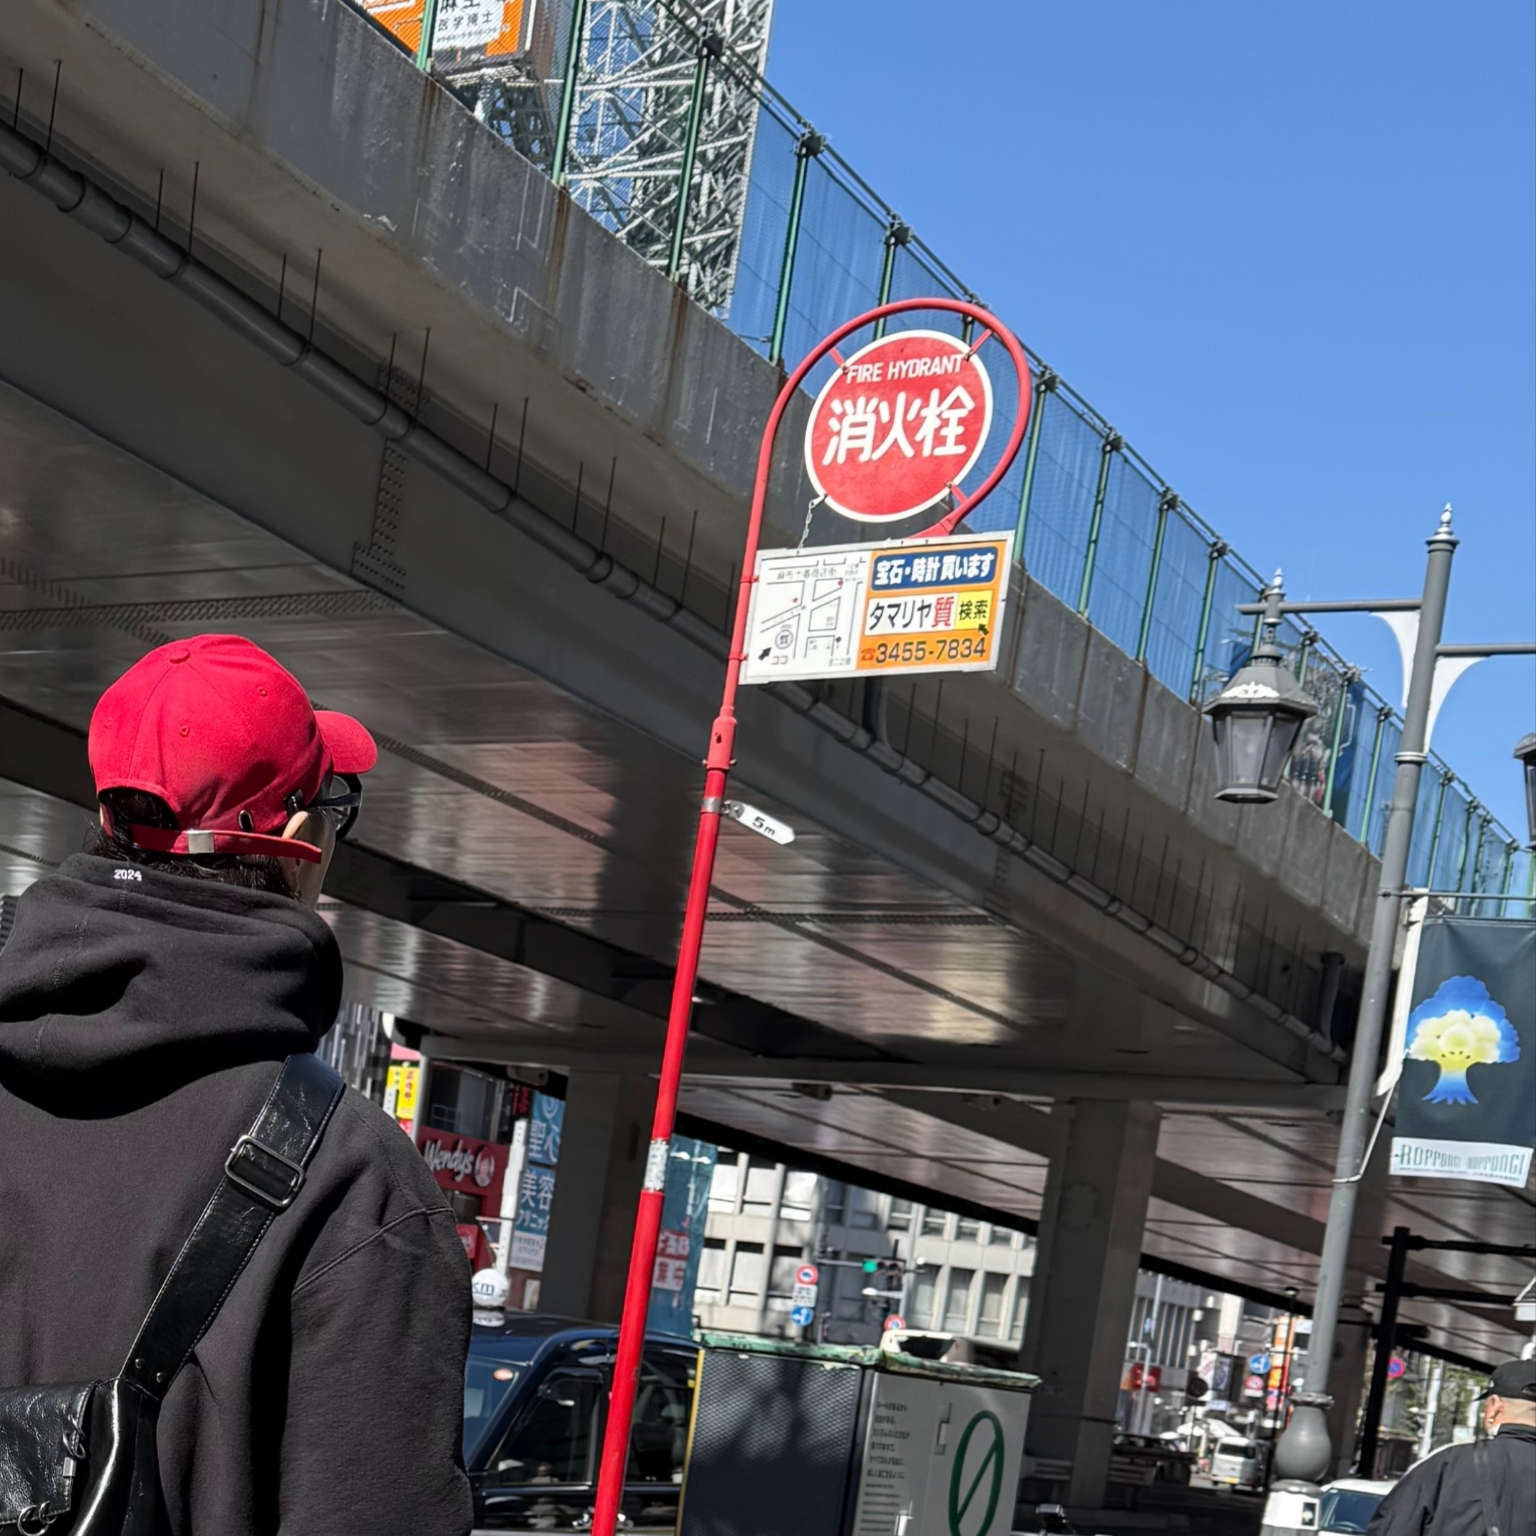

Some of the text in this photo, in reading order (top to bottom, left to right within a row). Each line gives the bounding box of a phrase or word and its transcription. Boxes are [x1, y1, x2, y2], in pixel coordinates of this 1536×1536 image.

[846, 353, 964, 385] FIRE HYDRANT
[821, 385, 976, 467] 消火栓
[958, 599, 989, 622] 検索
[875, 637, 986, 664] 3455-7834
[114, 869, 142, 881] 2024
[521, 1170, 555, 1211] 美容
